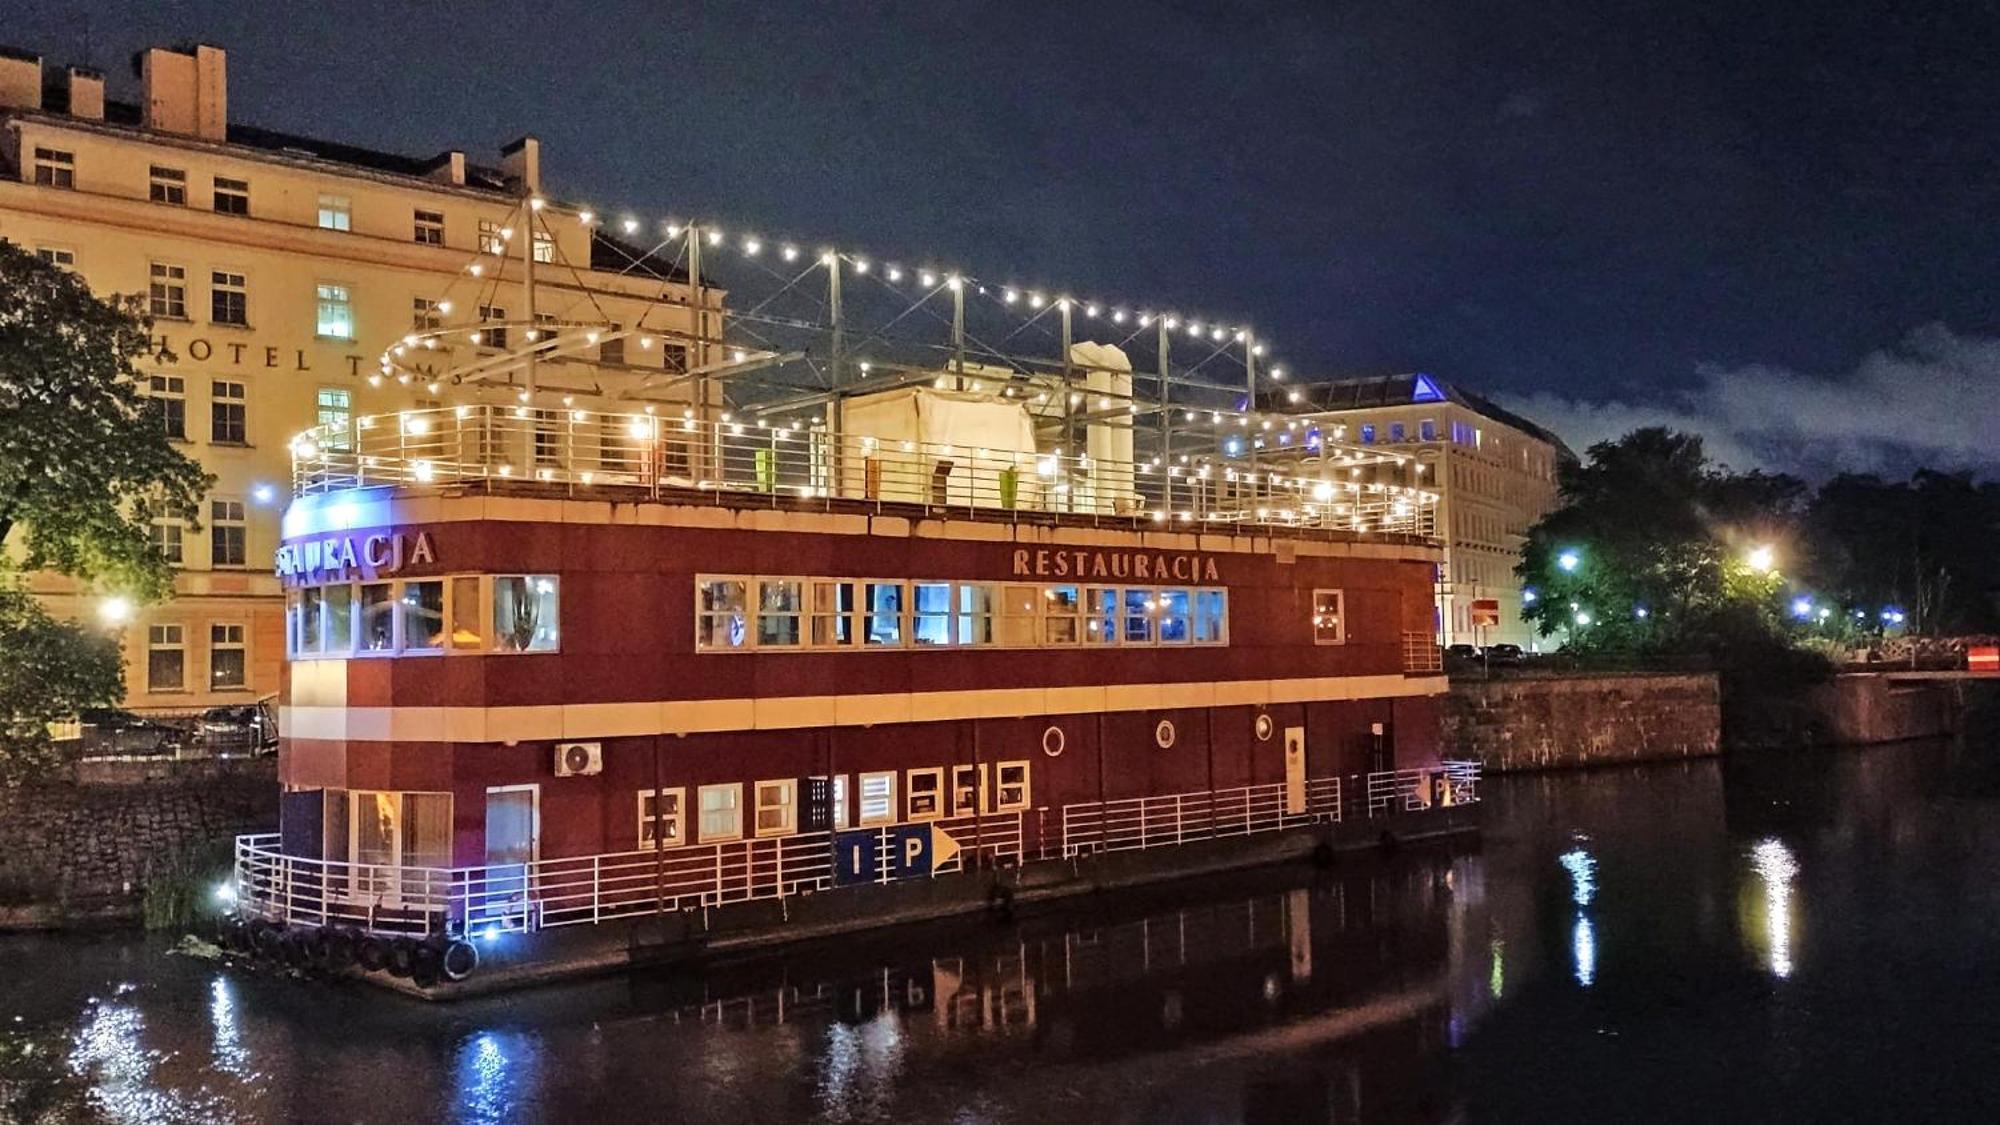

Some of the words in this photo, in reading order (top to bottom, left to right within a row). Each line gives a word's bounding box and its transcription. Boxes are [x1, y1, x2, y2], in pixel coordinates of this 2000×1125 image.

[148, 334, 311, 372] HOTEL
[345, 354, 514, 387] TMSI
[1013, 549, 1219, 584] RESTAURACJA
[905, 837, 923, 867] P
